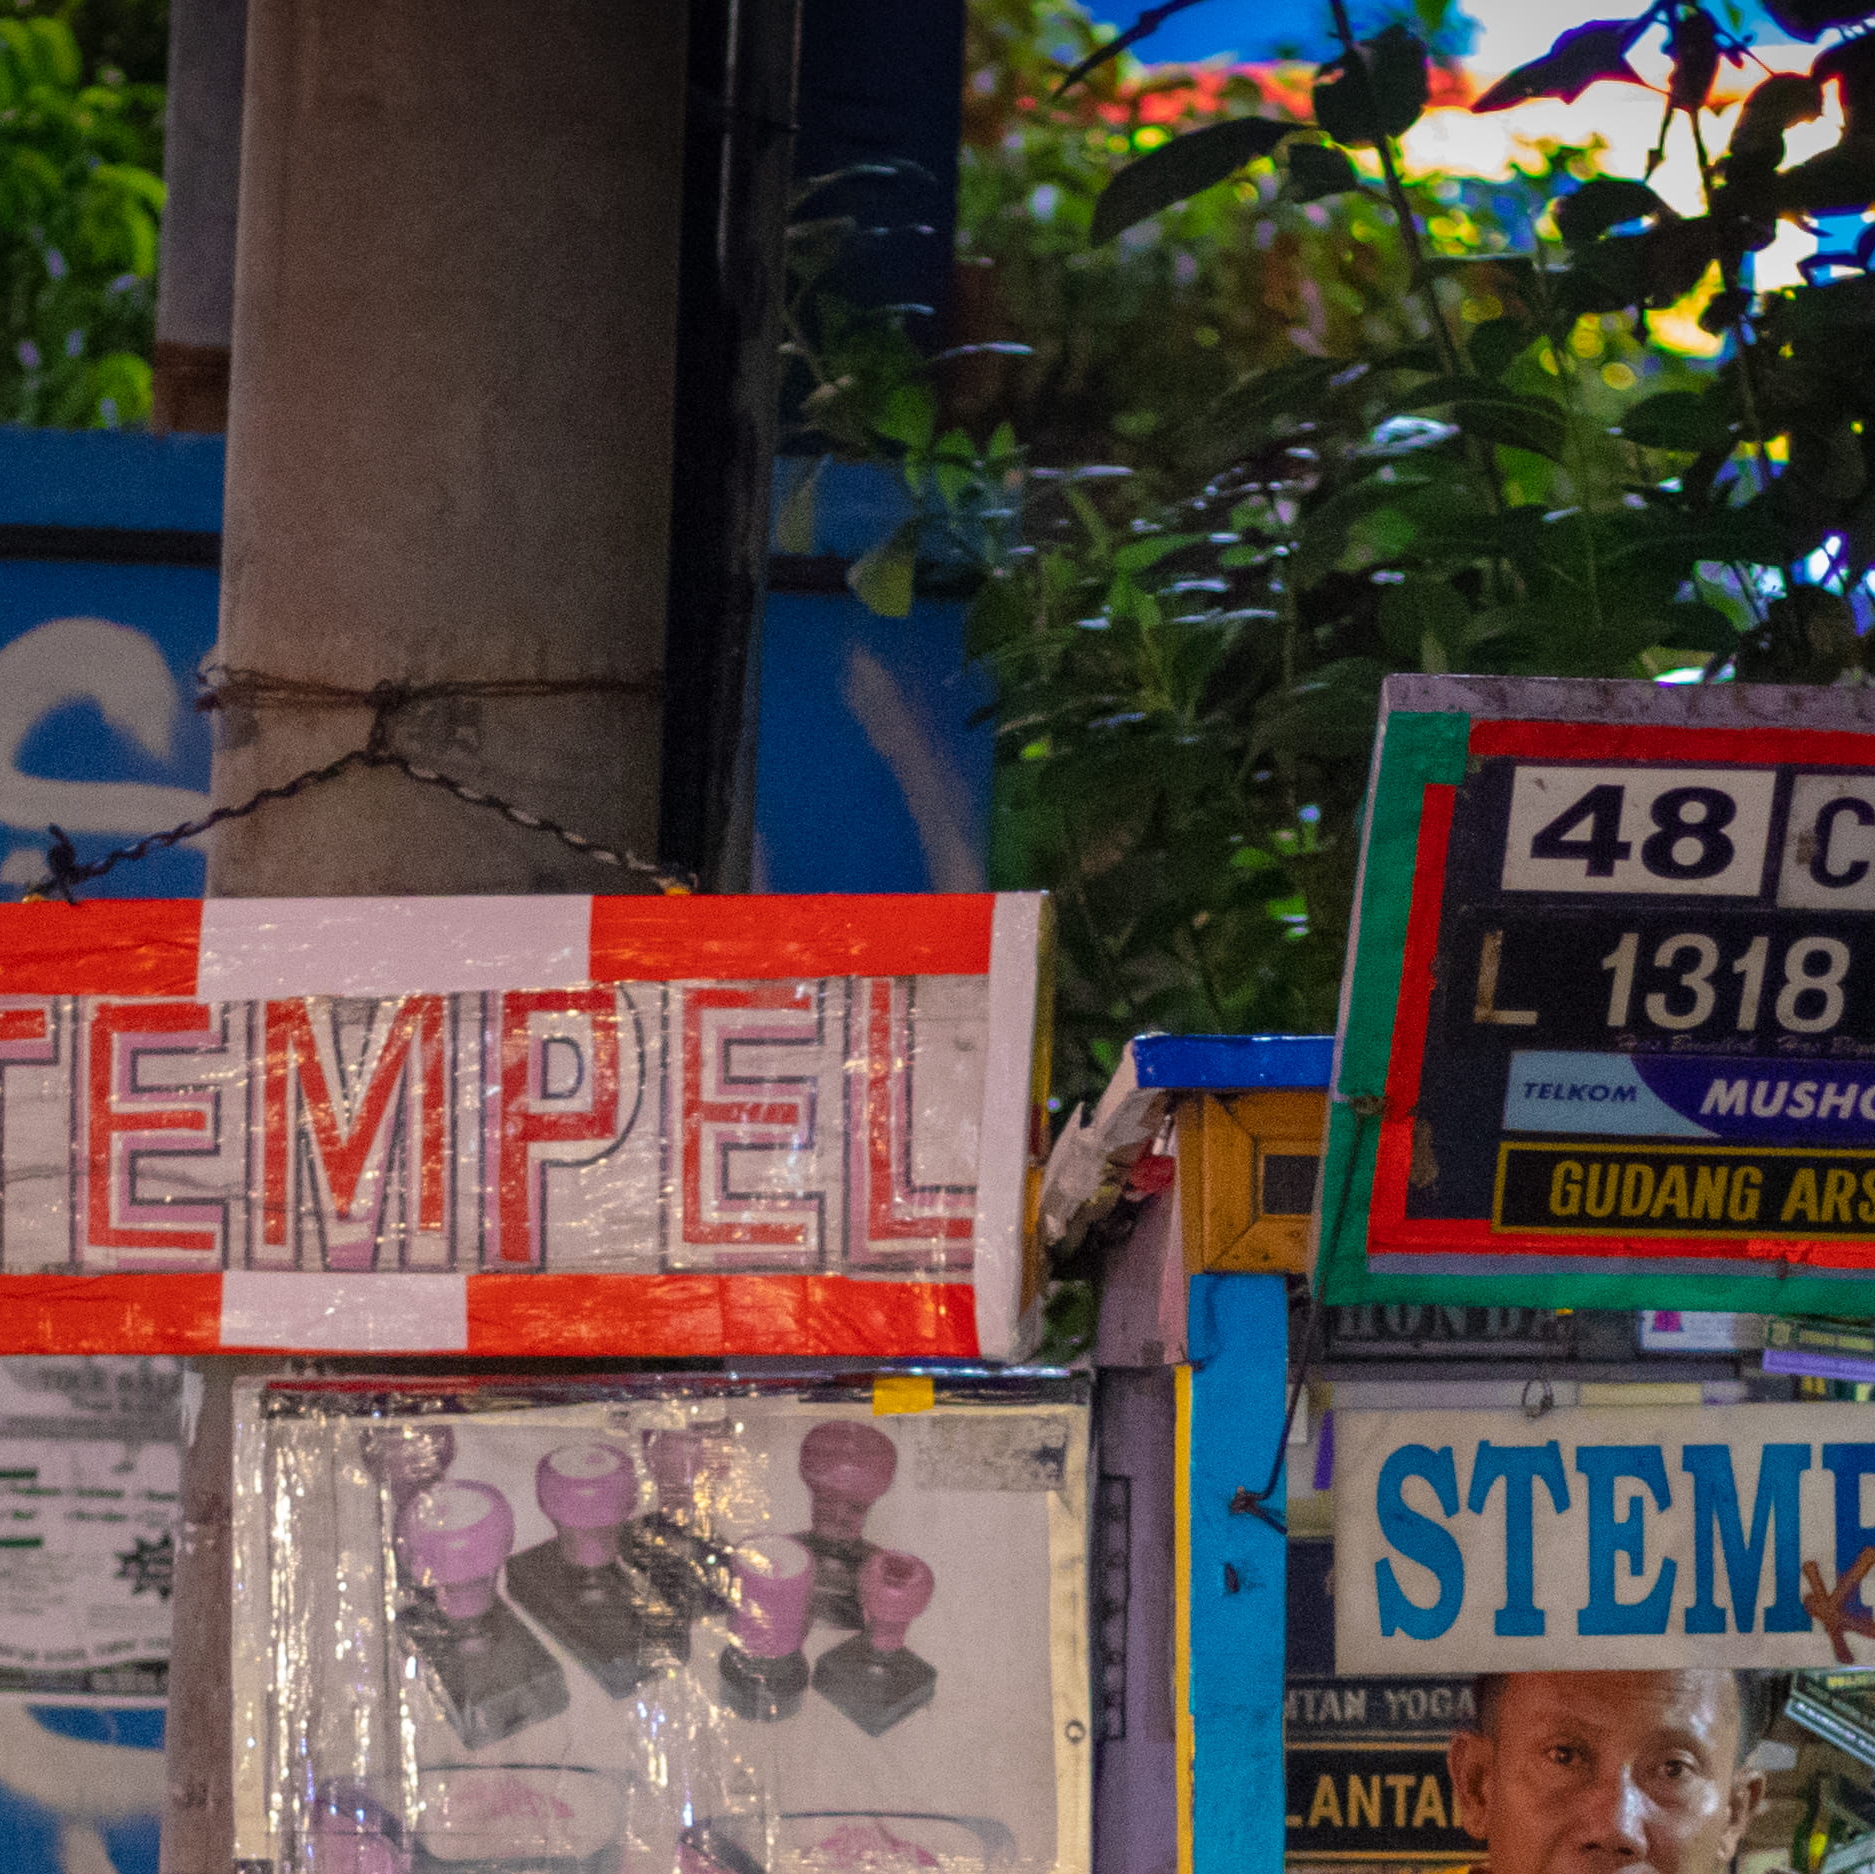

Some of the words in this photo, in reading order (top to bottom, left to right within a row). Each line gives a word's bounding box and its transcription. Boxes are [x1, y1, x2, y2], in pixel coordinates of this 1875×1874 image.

[1531, 783, 1737, 880] 48
[1473, 929, 1538, 1026] L
[1600, 932, 1851, 1033] 1318
[1523, 1081, 1639, 1104] TELKOM
[1548, 1160, 1764, 1221] GUDANG
